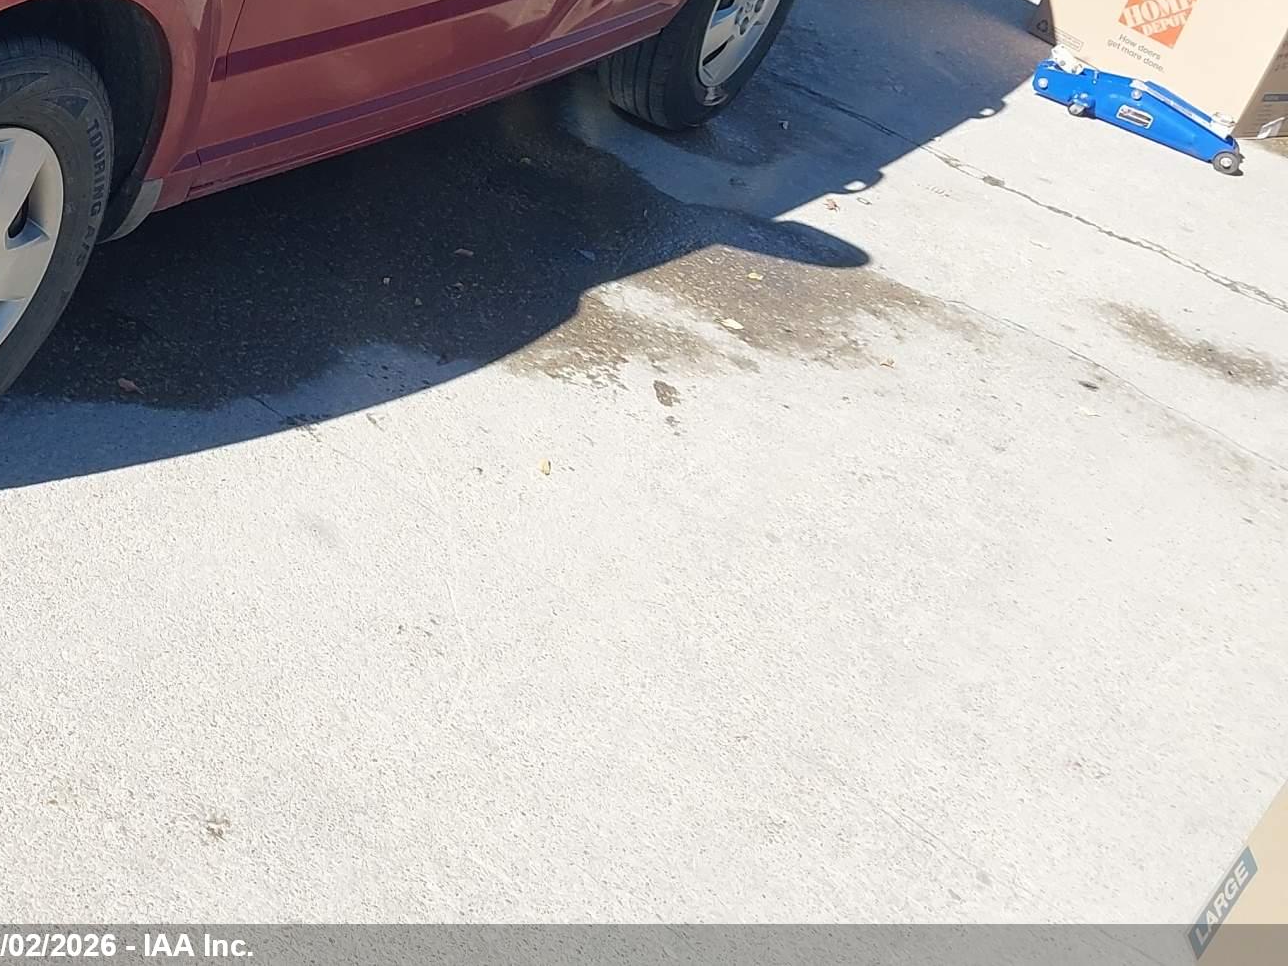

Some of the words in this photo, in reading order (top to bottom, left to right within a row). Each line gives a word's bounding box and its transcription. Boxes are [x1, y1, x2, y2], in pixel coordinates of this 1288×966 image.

[1142, 11, 1190, 35] DEPOT
[1107, 39, 1121, 53] get
[1119, 33, 1137, 48] How
[87, 118, 106, 217] TOURING
[1195, 860, 1249, 945] LARGE
